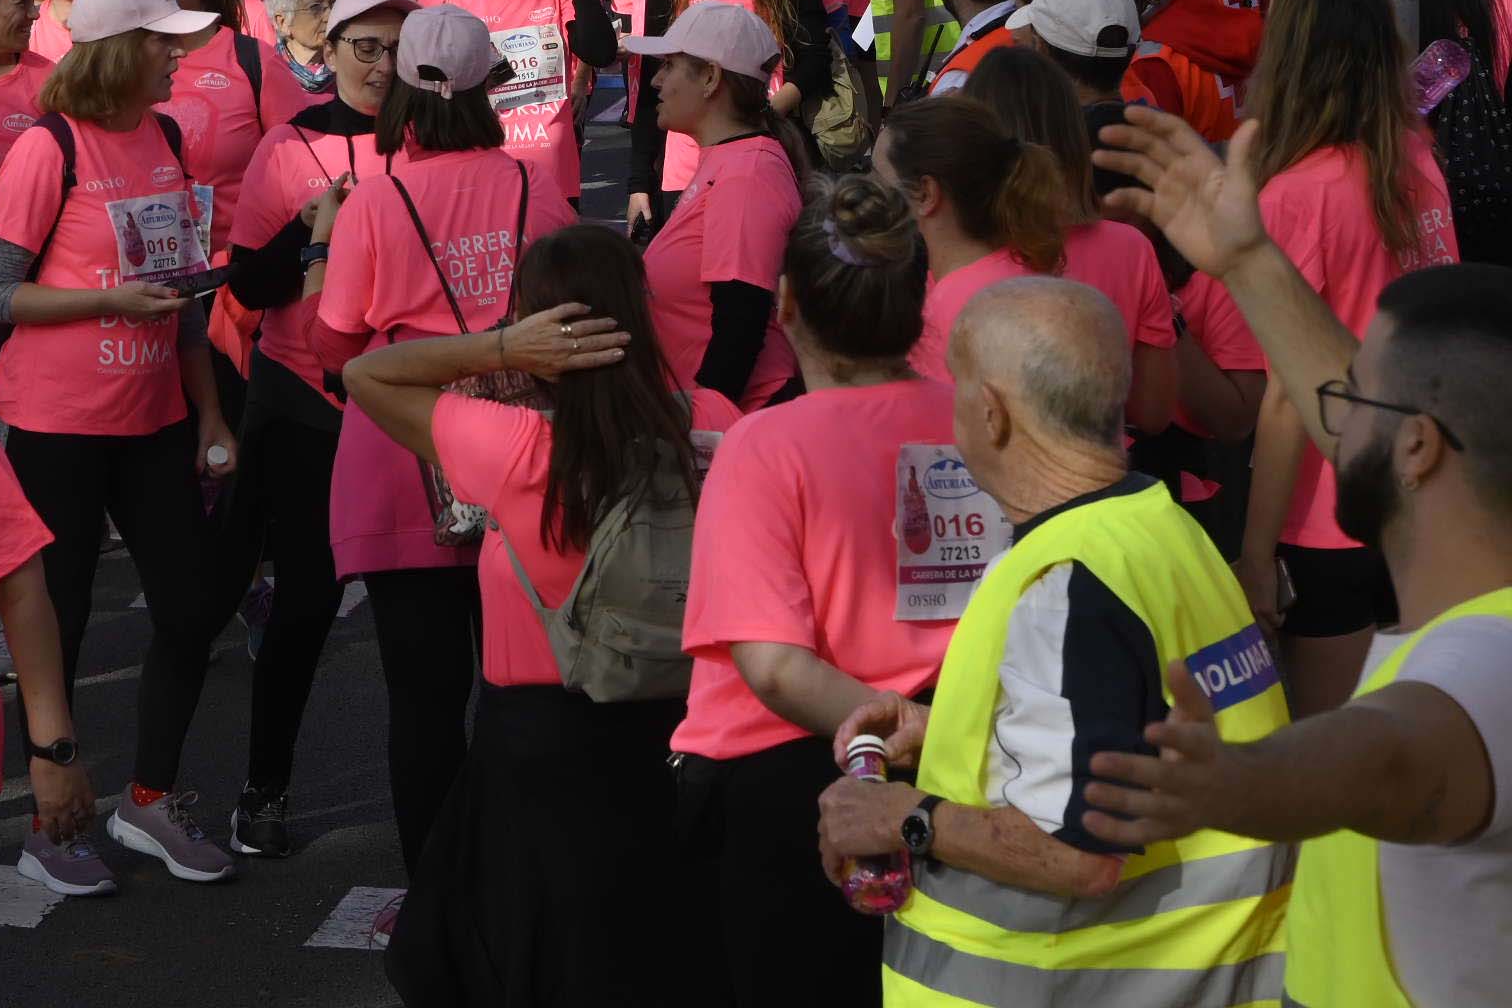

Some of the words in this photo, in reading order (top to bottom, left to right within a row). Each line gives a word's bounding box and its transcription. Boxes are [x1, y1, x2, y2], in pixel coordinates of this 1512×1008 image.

[146, 236, 178, 255] 016
[450, 257, 479, 277] DE
[485, 254, 514, 275] LA
[449, 269, 516, 299] MUJE
[476, 296, 498, 306] 2023
[97, 338, 173, 367] SUMA
[934, 512, 985, 539] 016
[940, 545, 981, 562] 27213
[911, 570, 944, 580] CARRERA
[944, 570, 956, 579] DE
[958, 569, 970, 579] LA
[907, 594, 947, 608] OYSHO
